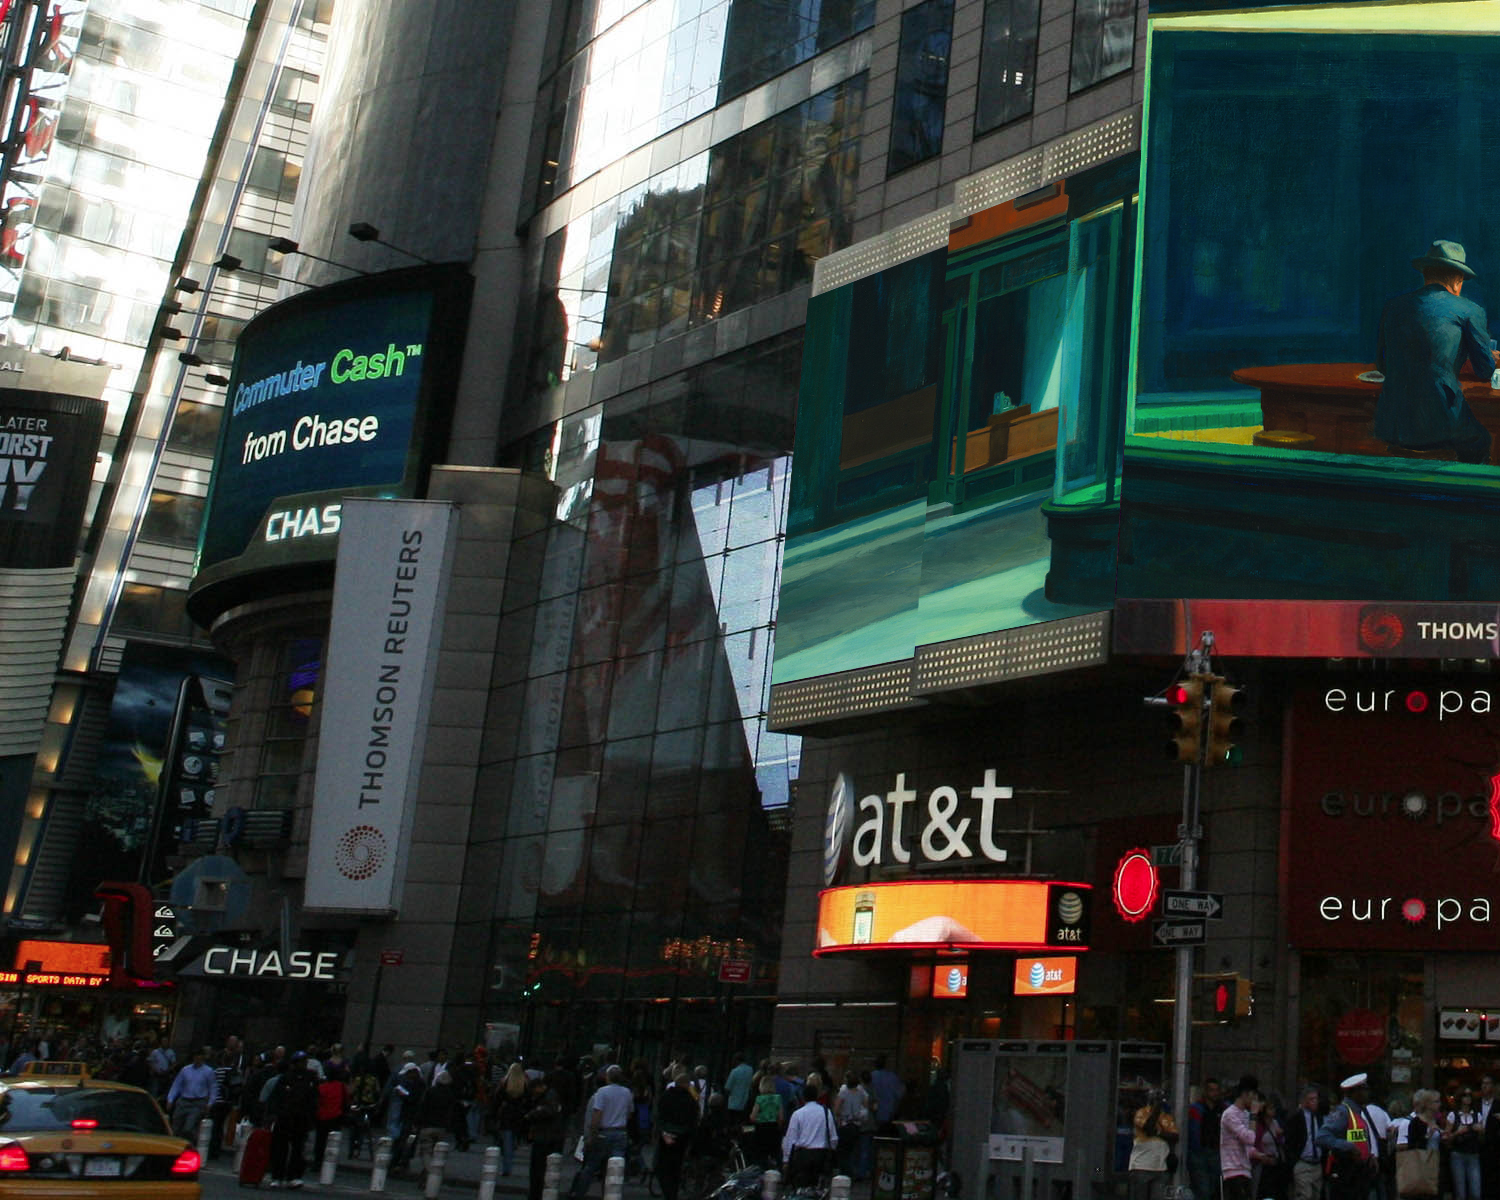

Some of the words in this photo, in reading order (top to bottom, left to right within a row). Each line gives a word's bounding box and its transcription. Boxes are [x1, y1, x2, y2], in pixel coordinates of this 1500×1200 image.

[233, 360, 327, 417] Commuter
[242, 430, 286, 464] from
[293, 415, 379, 451] Chase
[265, 504, 342, 542] CHAS
[357, 664, 400, 810] THOMSON
[384, 529, 423, 655] REUTERS
[1325, 687, 1491, 720] europa
[852, 769, 1013, 867] at&t
[1171, 898, 1189, 911] ONE
[1197, 901, 1215, 913] WAY
[1319, 896, 1490, 930] europa
[1057, 927, 1082, 942] at&t
[1160, 928, 1175, 938] ONE
[1183, 927, 1199, 937] WAY
[203, 947, 339, 979] CHASE
[26, 974, 60, 984] SPORTS
[63, 977, 86, 986] DATA
[89, 977, 102, 987] BY
